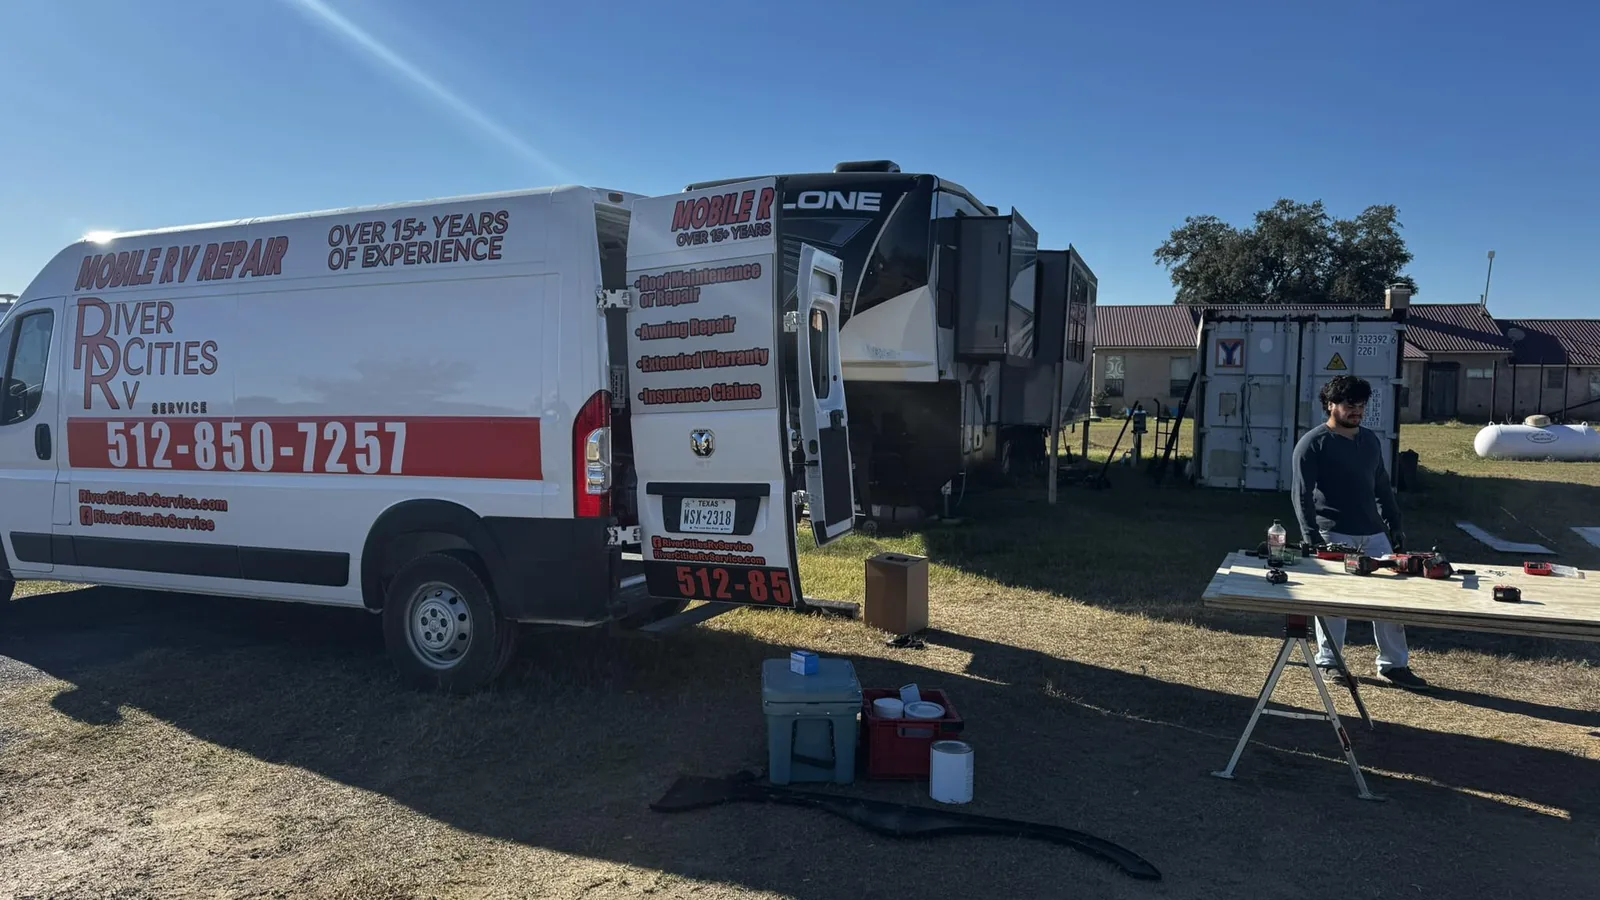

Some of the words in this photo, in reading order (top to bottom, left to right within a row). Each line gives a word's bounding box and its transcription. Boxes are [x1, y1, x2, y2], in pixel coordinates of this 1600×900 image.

[671, 189, 755, 232] MOBILE
[756, 187, 775, 221] R
[328, 221, 386, 247] OVER
[392, 218, 427, 242] 15+
[433, 210, 510, 239] YEARS
[676, 231, 708, 247] OVER
[711, 227, 730, 243] 15+
[732, 222, 772, 241] YEARS
[74, 247, 163, 291] MOBILE
[159, 245, 200, 284] RV
[197, 236, 289, 282] REPAIR
[328, 247, 358, 270] OF
[362, 236, 504, 268] EXPERIENCE
[639, 272, 670, 292] Roof
[670, 263, 761, 289] Maintenance
[640, 292, 655, 309] or
[655, 286, 700, 307] Repair
[73, 297, 174, 370] RIVER
[640, 321, 689, 341] Awning
[689, 315, 736, 337] Repair
[1330, 335, 1351, 345] YMLU
[1358, 335, 1388, 345] 332392
[123, 337, 218, 376] CITIES
[641, 351, 702, 373] Extended
[702, 347, 769, 369] Warranty
[1358, 347, 1377, 356] 22G1
[643, 386, 710, 405] Insurance
[711, 382, 762, 402] Claims
[151, 401, 207, 415] SERVICE
[106, 421, 407, 474] 512-850-7257
[78, 489, 228, 512] RiverCitiesRvService.com
[698, 500, 719, 508] TEXAS
[93, 509, 215, 532] RiverCitiesRvService
[653, 549, 766, 566] RiverCitiesRvService.com
[676, 566, 791, 603] 512-85
